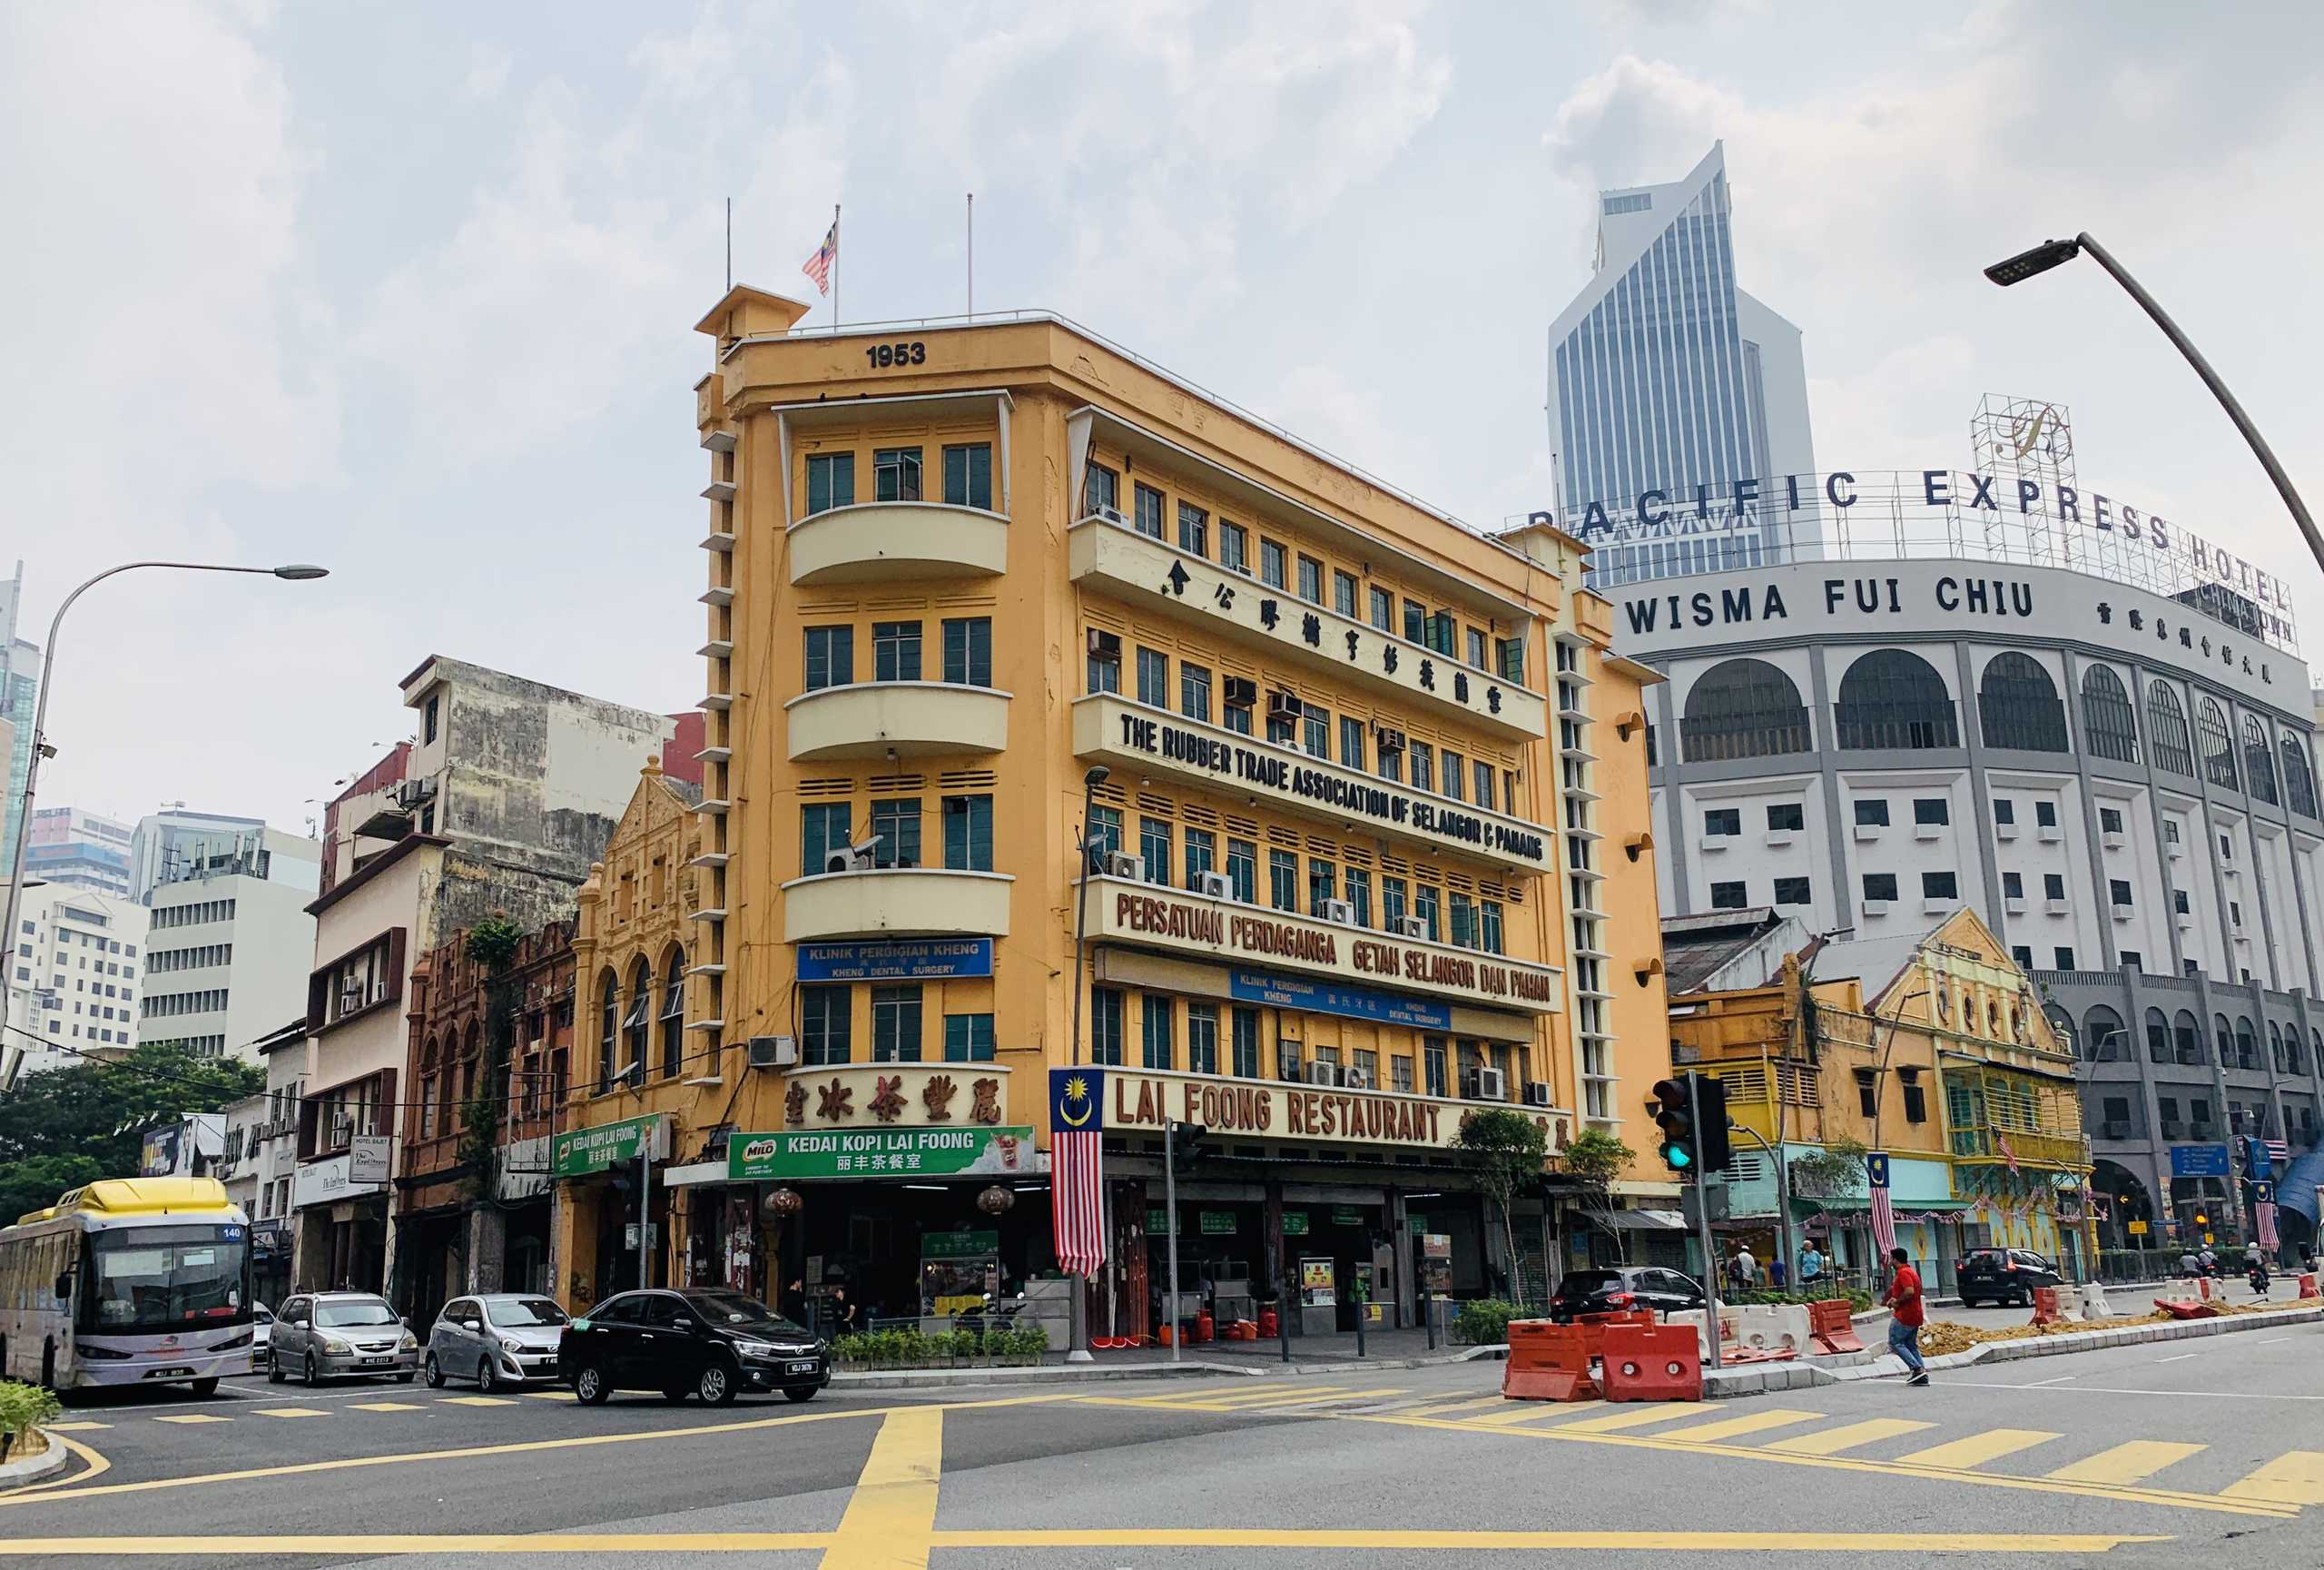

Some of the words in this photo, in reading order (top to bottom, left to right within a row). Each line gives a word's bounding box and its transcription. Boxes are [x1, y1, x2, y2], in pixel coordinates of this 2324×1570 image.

[866, 342, 926, 369] 1953
[1924, 470, 2170, 549] EXPRESS
[2191, 534, 2289, 611] HOTEL
[1625, 583, 1788, 635] WISMA
[1824, 578, 1902, 615] FUI
[1935, 577, 2034, 617] CHIU
[1121, 713, 1157, 753] THE
[1162, 726, 1232, 774] RUBBER
[1235, 748, 1290, 791] TRADE
[1292, 765, 1390, 819] ASSOCIATION
[1392, 795, 1410, 824] OF
[1412, 801, 1482, 844] SELANGOR
[1494, 824, 1543, 862] PAHANG
[809, 947, 853, 960] KLINIK
[858, 945, 929, 958] PERGIGIAN
[933, 943, 980, 956] KHENG
[1118, 893, 1225, 945] PERSATUAN
[1231, 914, 1337, 965] PERDAGANGA
[1353, 939, 1401, 977] GETAH
[1404, 950, 1476, 990] SELANGOR
[1480, 963, 1508, 997] DAN
[832, 967, 865, 978] KHENG
[871, 966, 906, 977] DENTAL
[912, 964, 956, 975] SURGERY
[1240, 973, 1269, 989] KLINIK
[1264, 990, 1293, 1004] KHENG
[1116, 1078, 1166, 1125] LAI
[1184, 1081, 1272, 1131] FOONG
[1287, 1091, 1441, 1143] RESTAURANT
[572, 1134, 590, 1152] KEDAI
[590, 1131, 605, 1148] KOPI
[605, 1130, 615, 1144] LAI
[616, 1125, 636, 1142] FOONG
[787, 1135, 838, 1153] KEDAI
[842, 1134, 882, 1152] KOPI
[886, 1133, 913, 1151] LAI
[918, 1131, 975, 1150] FOONG
[746, 1145, 774, 1157] MILO
[836, 1153, 922, 1171] 丽丰茶餐室
[223, 1228, 241, 1238] 140
